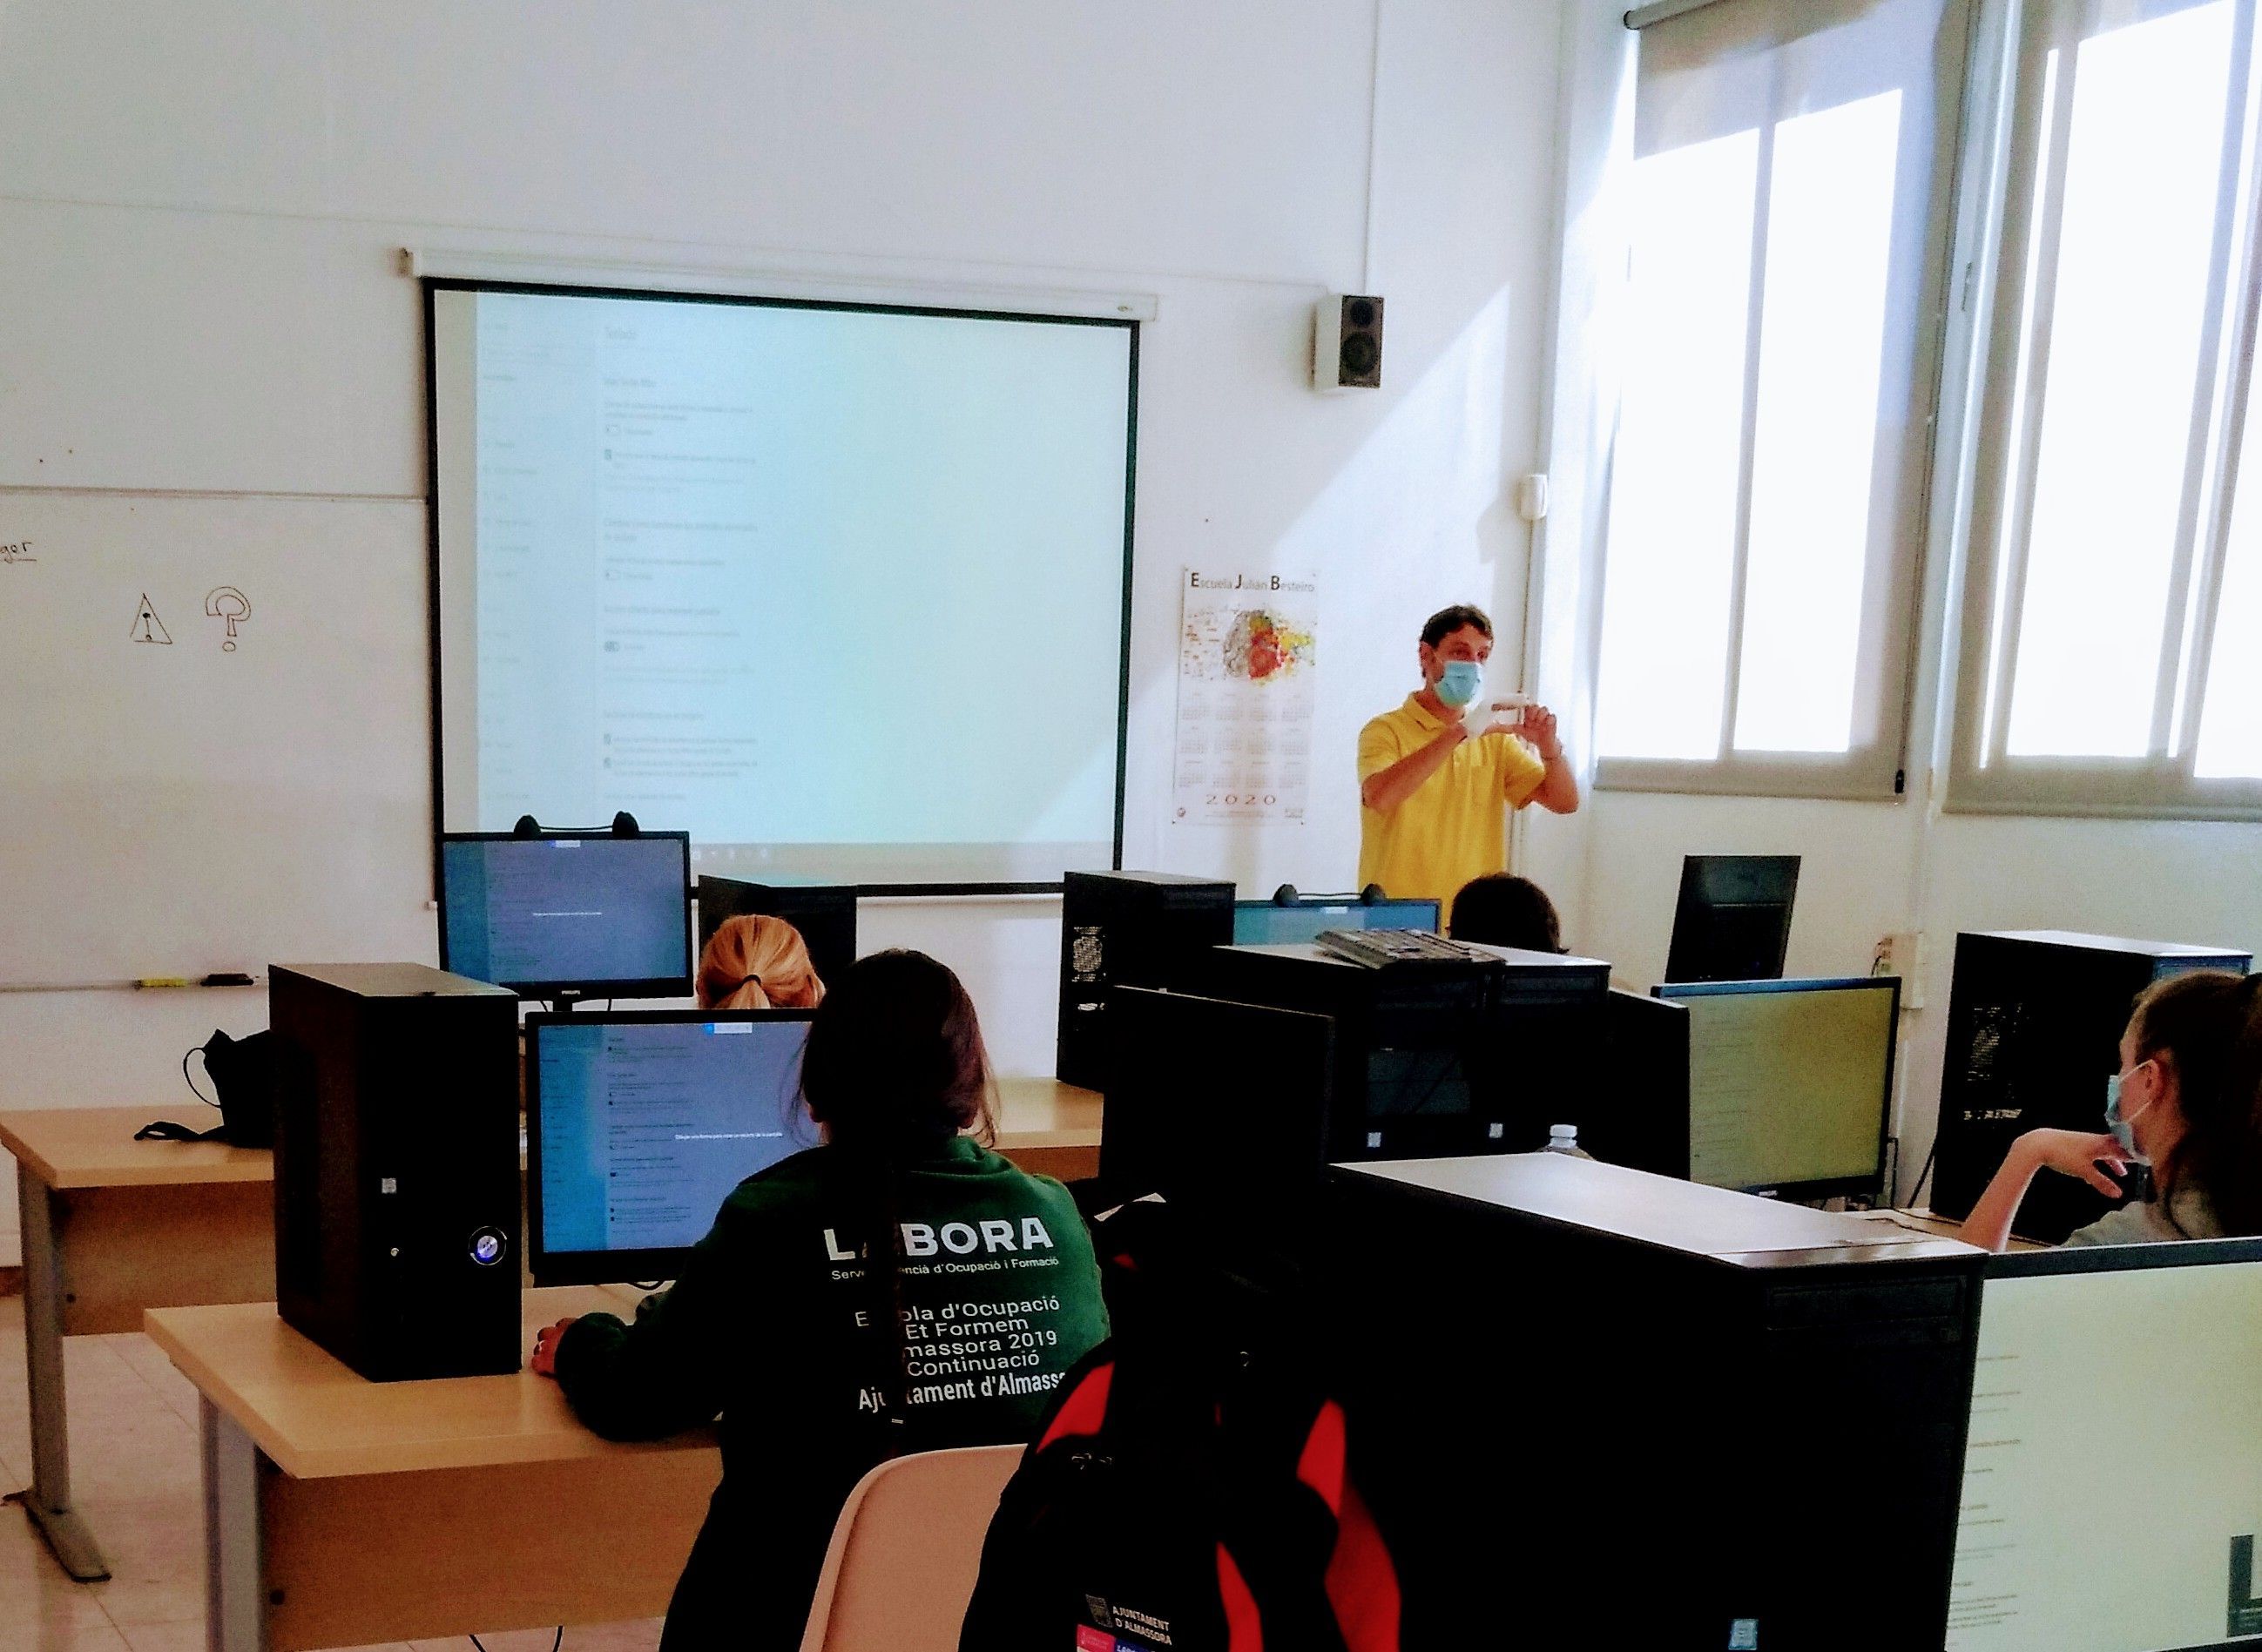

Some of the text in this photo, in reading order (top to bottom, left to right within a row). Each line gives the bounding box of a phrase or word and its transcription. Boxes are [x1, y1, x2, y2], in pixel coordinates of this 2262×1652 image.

[1205, 793, 1276, 806] 2020
[824, 1217, 1054, 1261] LBORA
[933, 1258, 1001, 1274] d'Ocupació
[1011, 1256, 1060, 1269] Formació
[941, 1295, 1061, 1319] d'Ocupació
[905, 1318, 1030, 1340] Et Formem
[902, 1330, 1058, 1358] massora 2019
[907, 1349, 1040, 1377] Continuació
[1112, 1605, 1170, 1632] AJUNTAMENT
